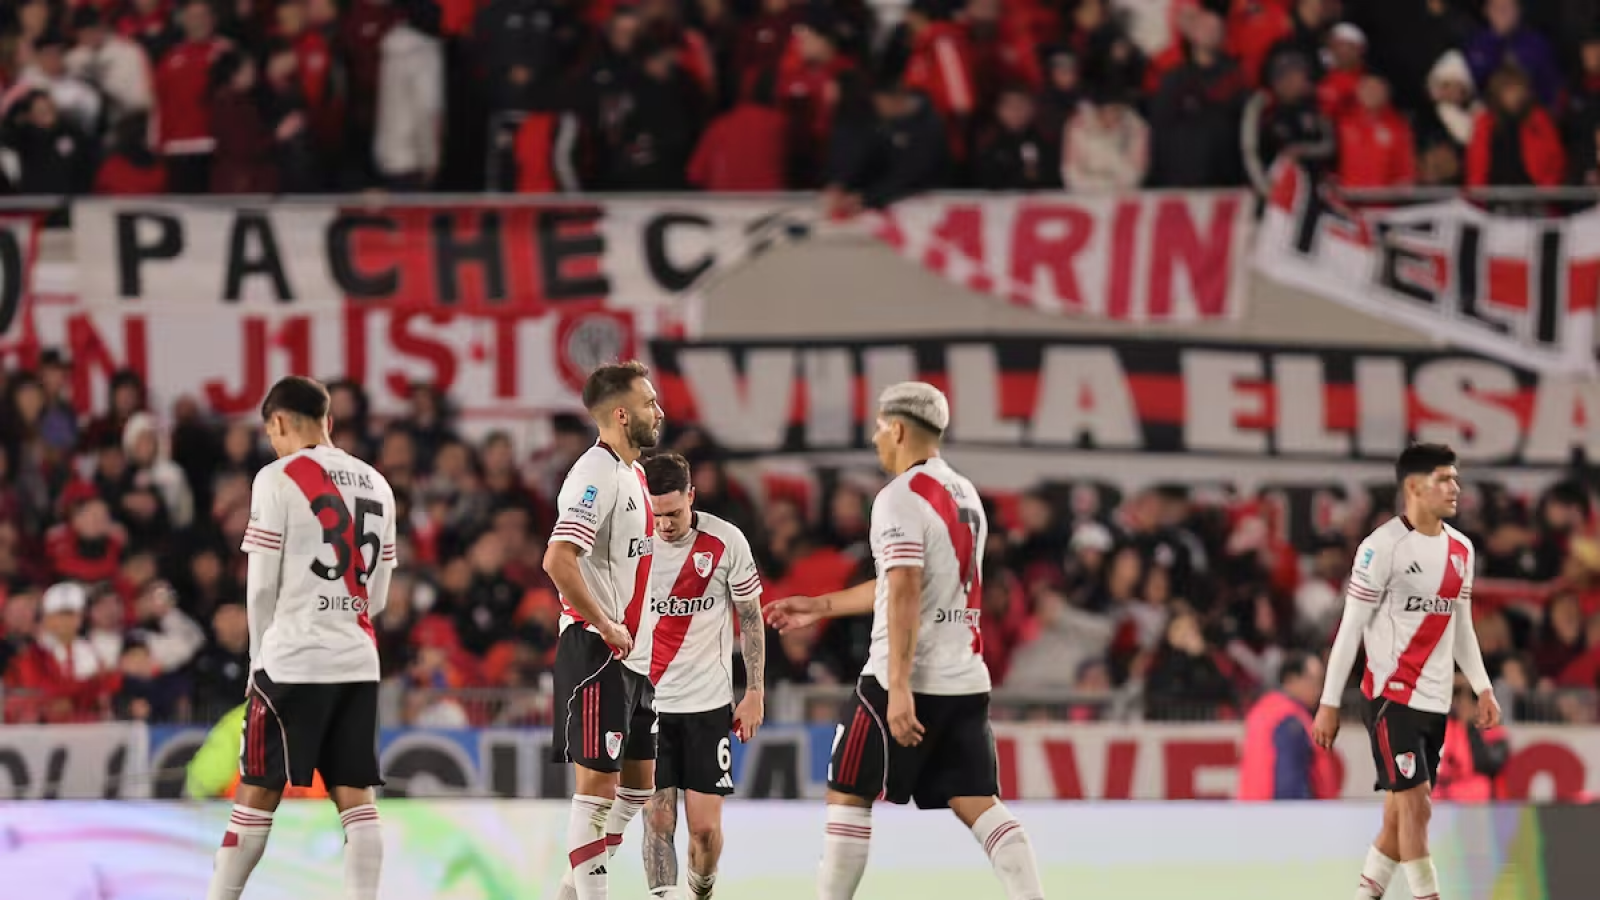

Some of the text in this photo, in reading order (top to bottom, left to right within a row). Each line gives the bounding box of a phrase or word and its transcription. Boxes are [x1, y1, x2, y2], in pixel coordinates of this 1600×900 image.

[1182, 350, 1600, 464] ELISA
[309, 494, 384, 587] 35
[650, 596, 715, 615] etano
[716, 736, 732, 771] 6
